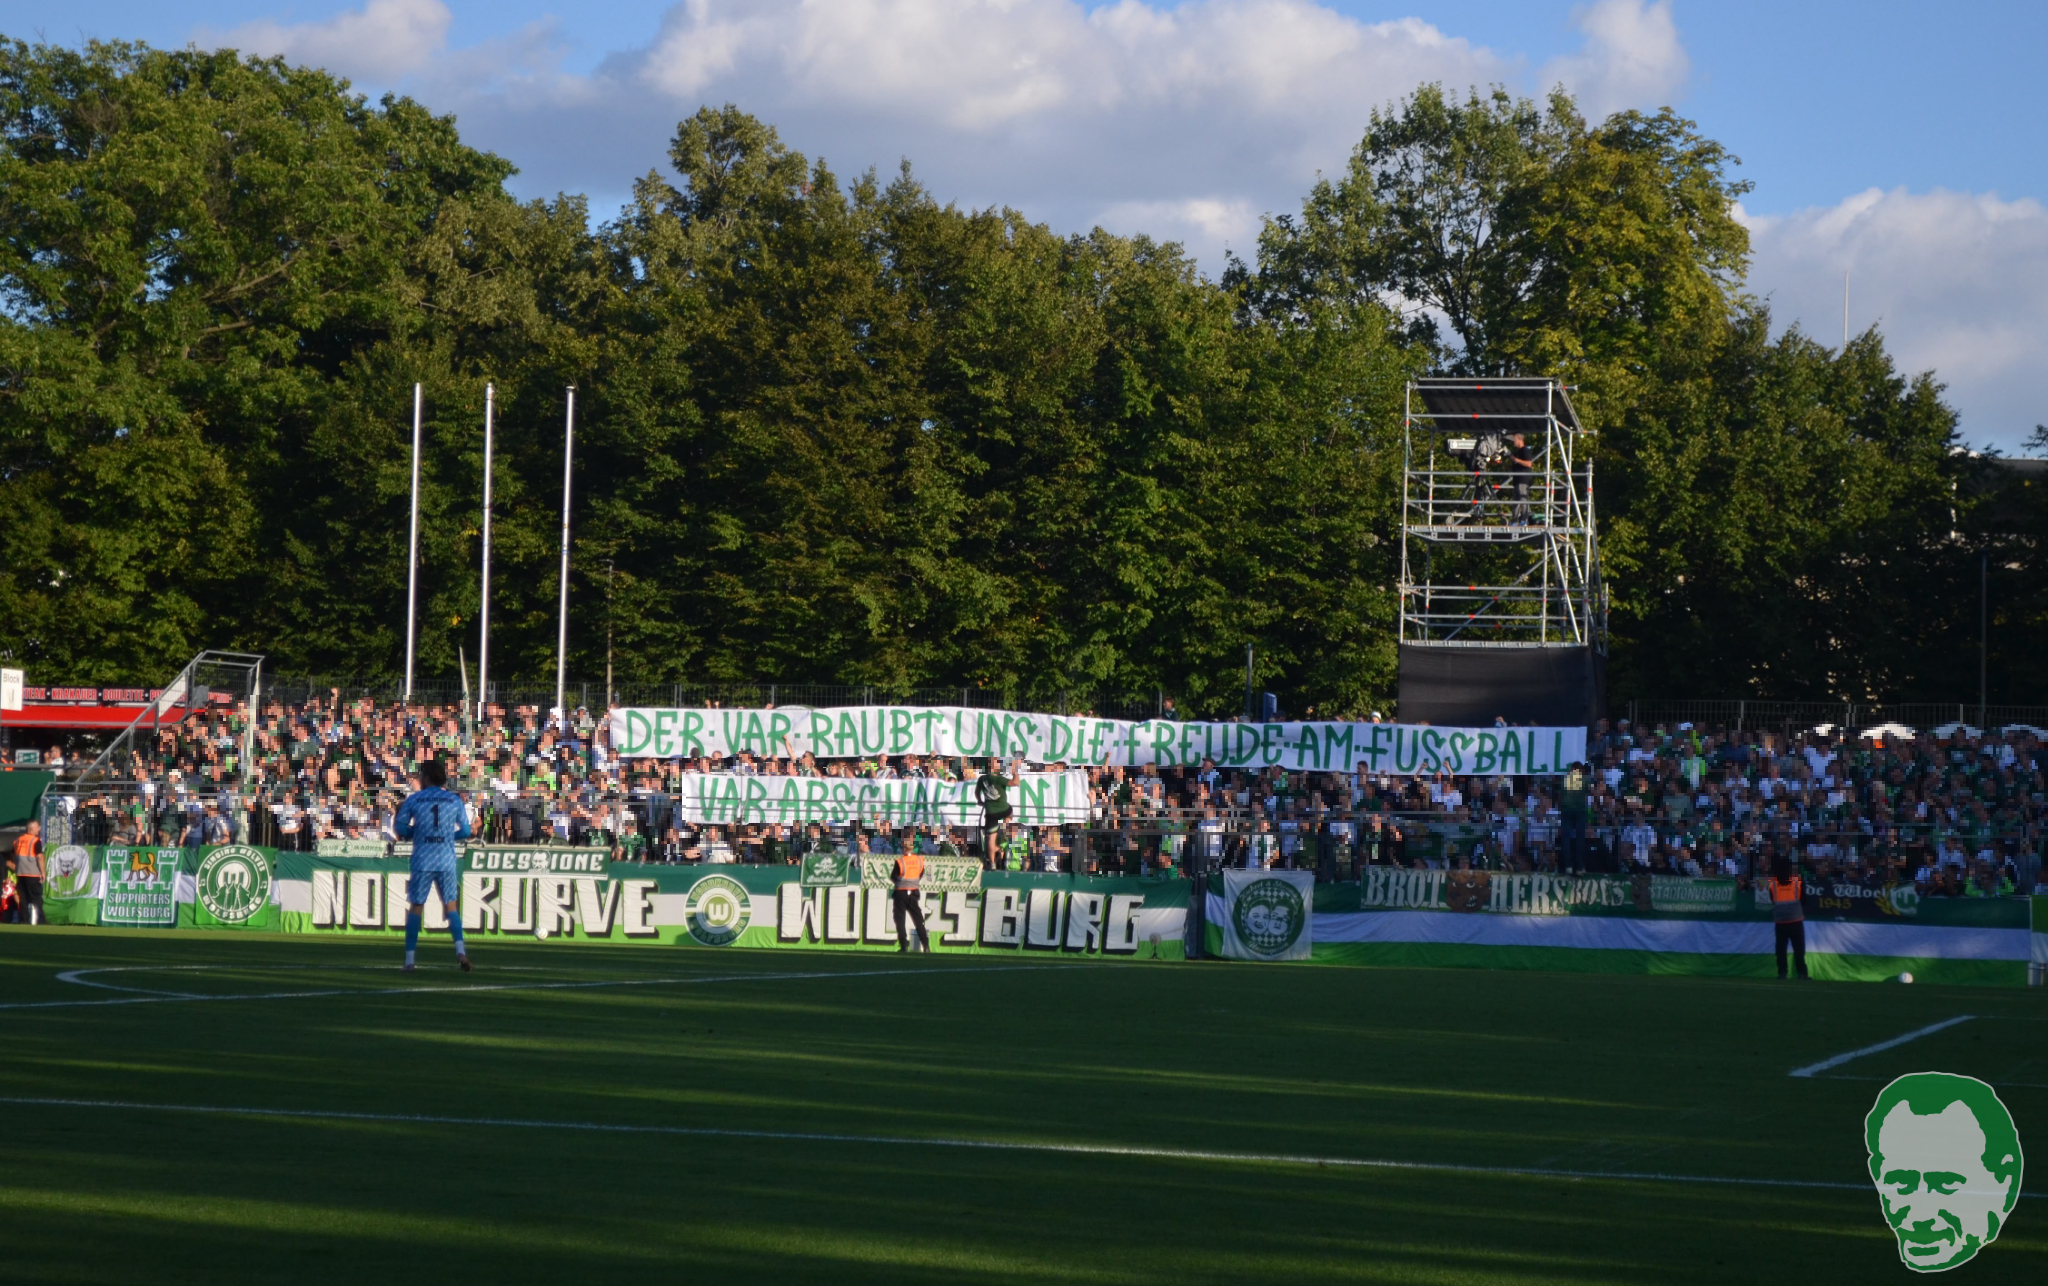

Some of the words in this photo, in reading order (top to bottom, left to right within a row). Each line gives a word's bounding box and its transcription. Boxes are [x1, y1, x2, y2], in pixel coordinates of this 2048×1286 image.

[51, 687, 97, 701] KRAKAUER
[102, 688, 145, 702] BOULETTE
[618, 709, 705, 756] DER
[723, 711, 792, 756] VAR
[807, 708, 945, 756] RAUBT
[954, 711, 1038, 758] UNS
[1124, 723, 1284, 768] FREUDE
[1292, 724, 1353, 770] AM
[1362, 726, 1574, 774] FUSSBALL
[699, 776, 768, 822] VAR
[777, 774, 1066, 825] ABSCHAFFN!
[430, 804, 439, 831] 1
[203, 848, 236, 870] SINGING
[239, 847, 266, 872] WOLVES
[108, 892, 171, 905] SUPPORTERS
[690, 878, 746, 902] NORDKURVE
[1650, 885, 1735, 901] STADIONVERBOT
[107, 905, 171, 918] WOLFSBURG
[202, 894, 262, 919] WOLFSBURG
[1818, 897, 1852, 910] 1945
[690, 918, 747, 944] WOLFSBURG
